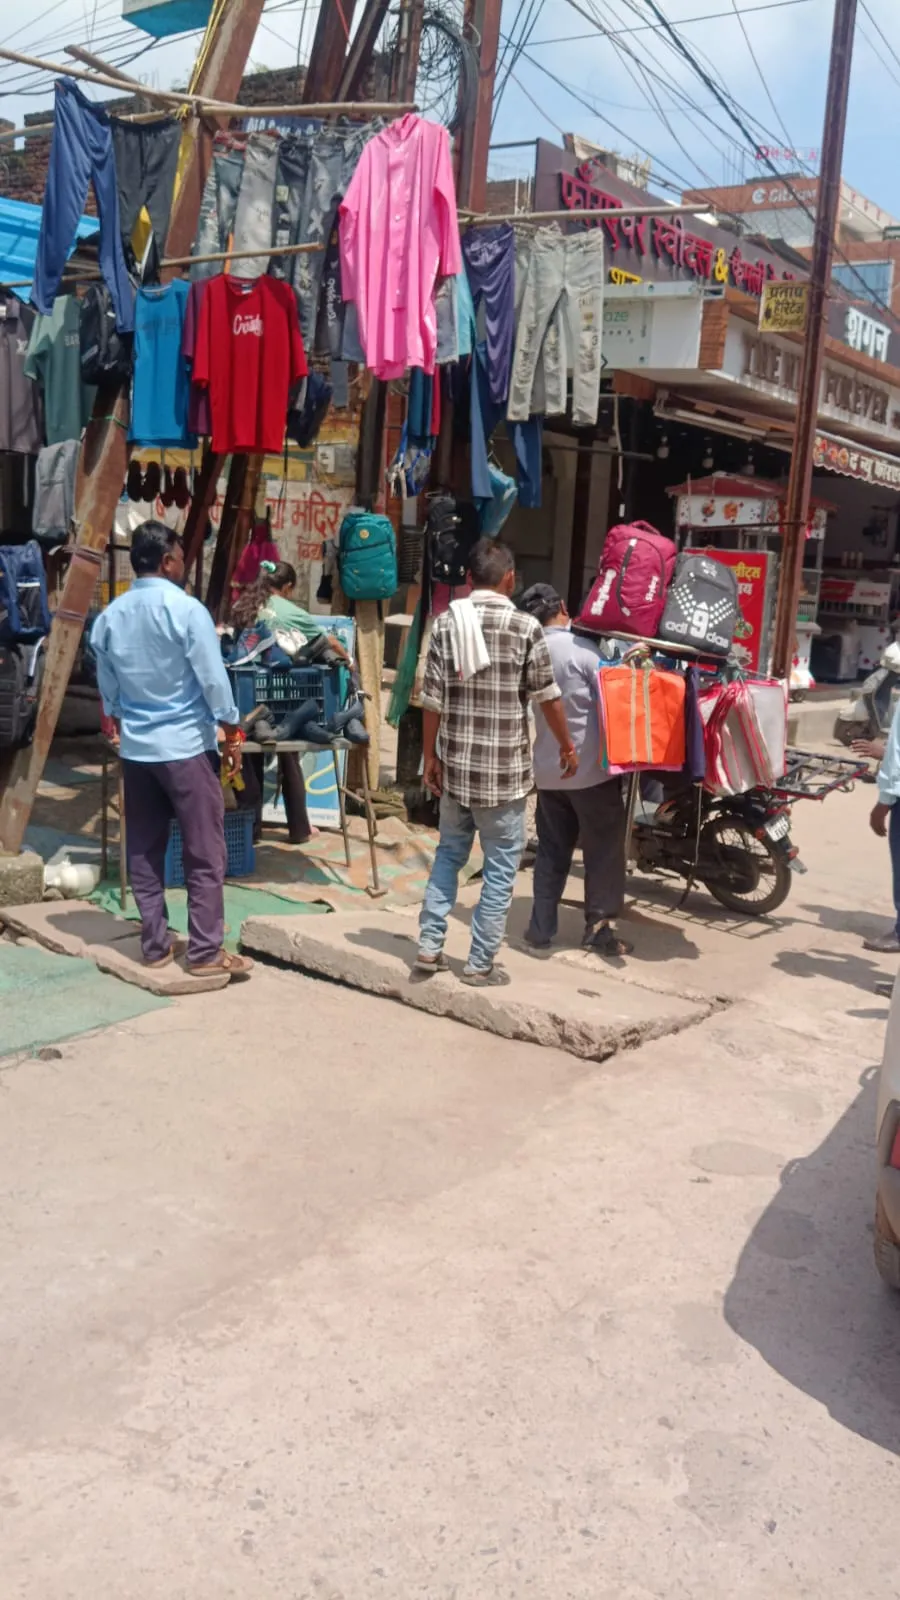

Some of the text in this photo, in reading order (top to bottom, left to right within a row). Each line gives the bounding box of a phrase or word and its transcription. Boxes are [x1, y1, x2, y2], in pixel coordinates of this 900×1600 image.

[715, 247, 729, 283] &
[292, 490, 342, 538] मंदिर
[690, 609, 709, 639] 9
